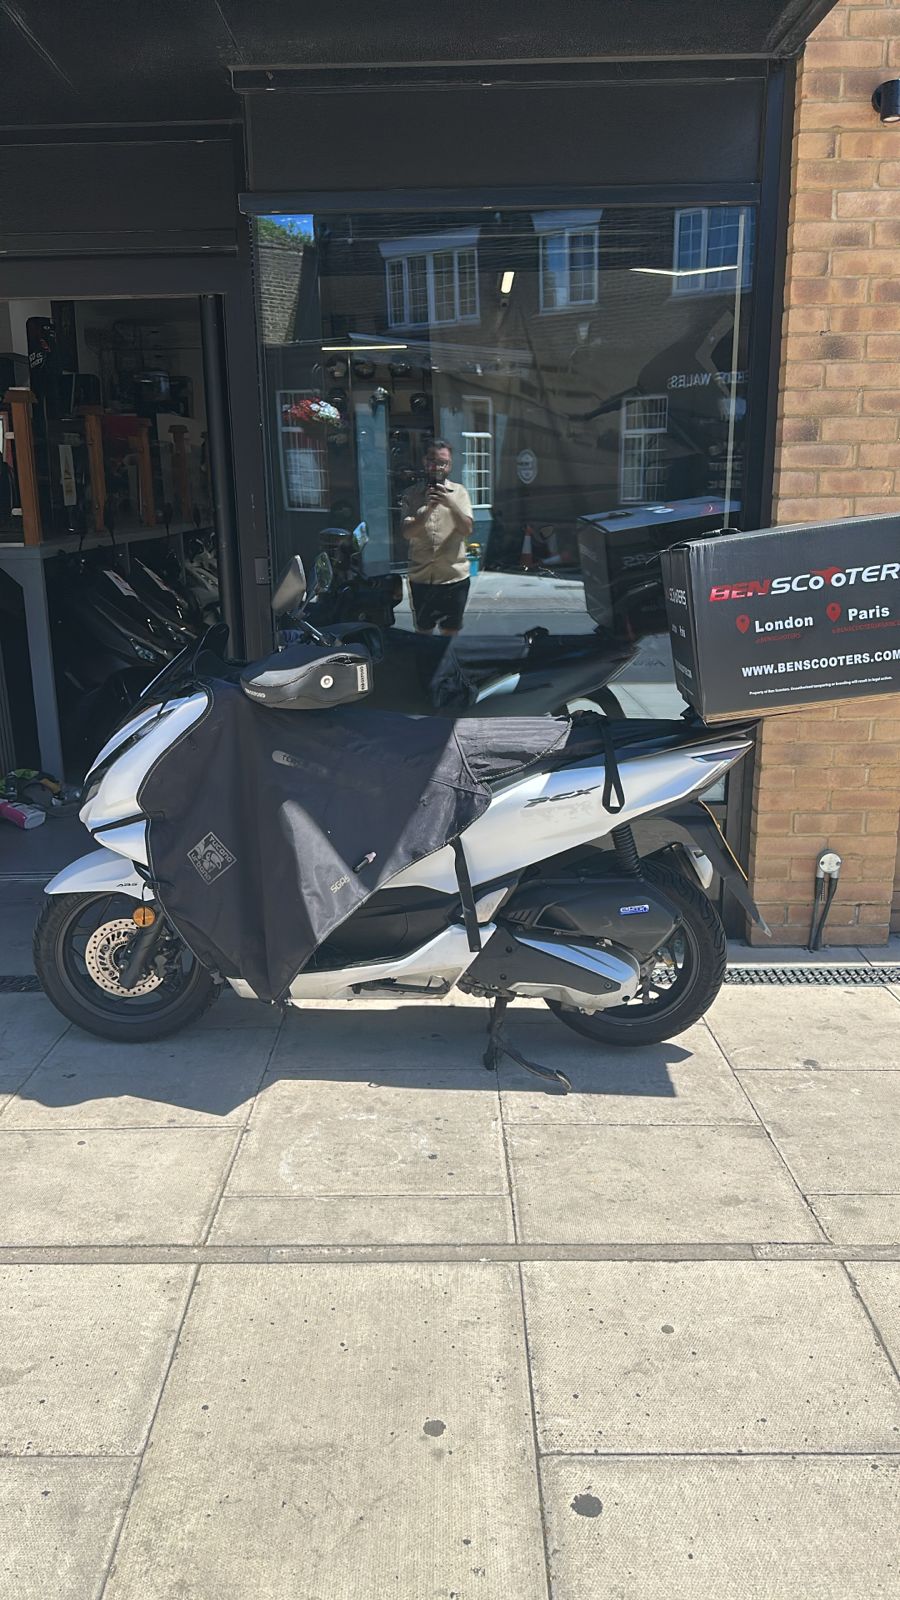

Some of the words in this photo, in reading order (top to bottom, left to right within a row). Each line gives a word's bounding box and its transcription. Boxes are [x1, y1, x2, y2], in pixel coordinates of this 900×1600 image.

[754, 616, 814, 633] London
[847, 605, 890, 621] Paris
[741, 649, 900, 678] WWW.BENSCOOTERS.COM
